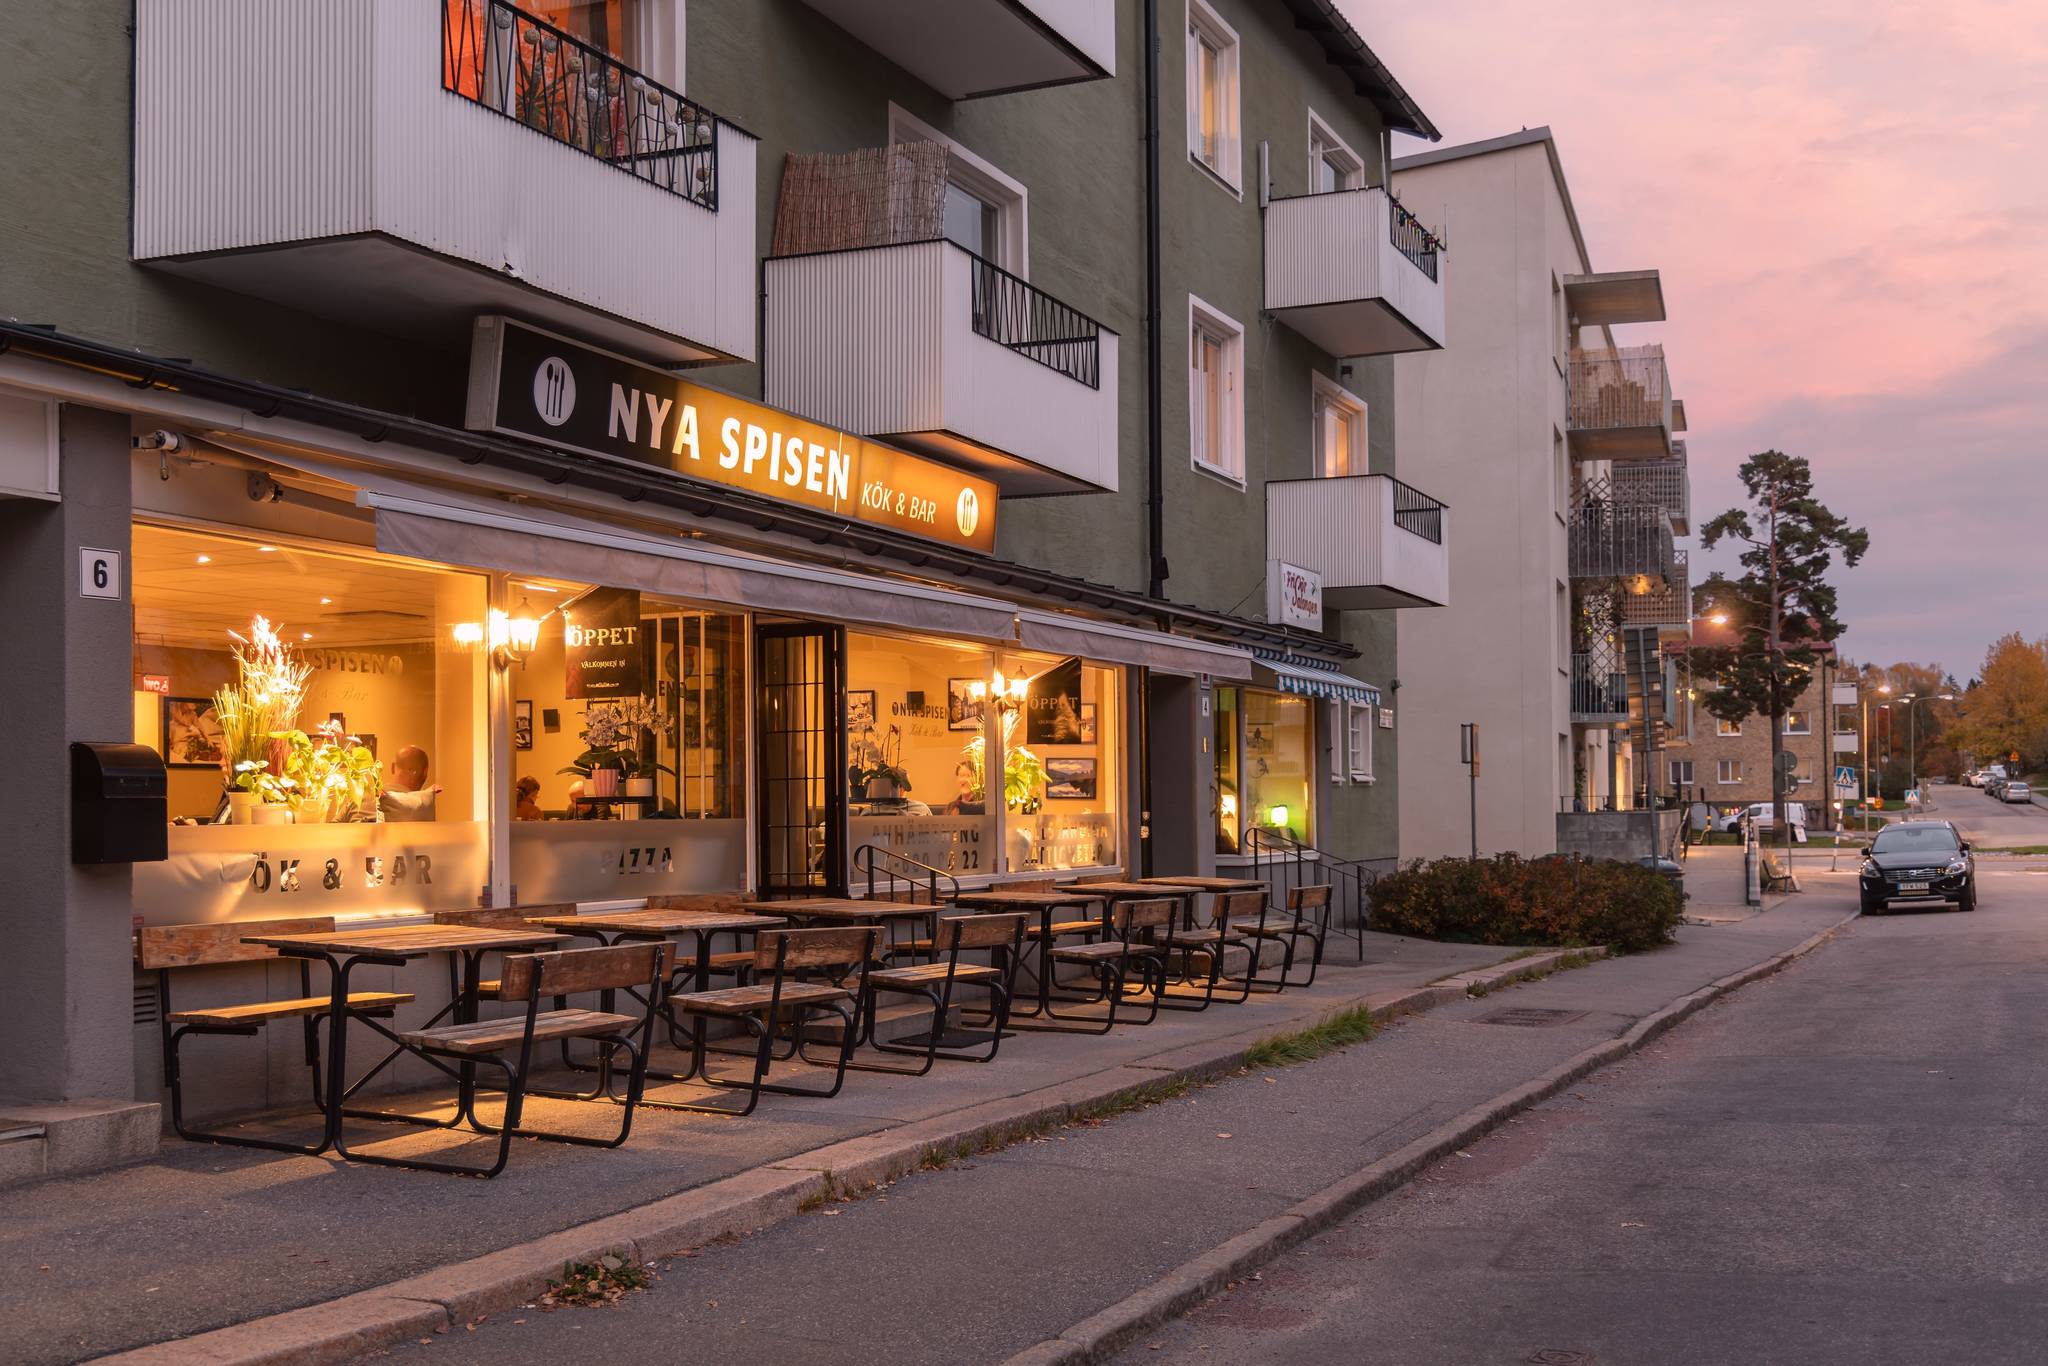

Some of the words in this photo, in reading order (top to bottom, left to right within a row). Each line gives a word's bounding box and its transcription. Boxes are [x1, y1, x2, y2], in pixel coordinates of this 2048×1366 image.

[608, 382, 700, 460] NYA
[719, 416, 851, 501] SPISEN
[861, 480, 892, 513] KÖK
[895, 491, 907, 516] &
[909, 497, 936, 524] BAR
[93, 559, 108, 589] 6
[571, 624, 637, 647] ÖPPET
[313, 649, 385, 675] SPISEN
[1030, 695, 1078, 710] ÖPPT
[323, 857, 344, 890] &
[365, 855, 432, 888] BAR
[962, 850, 978, 869] 22
